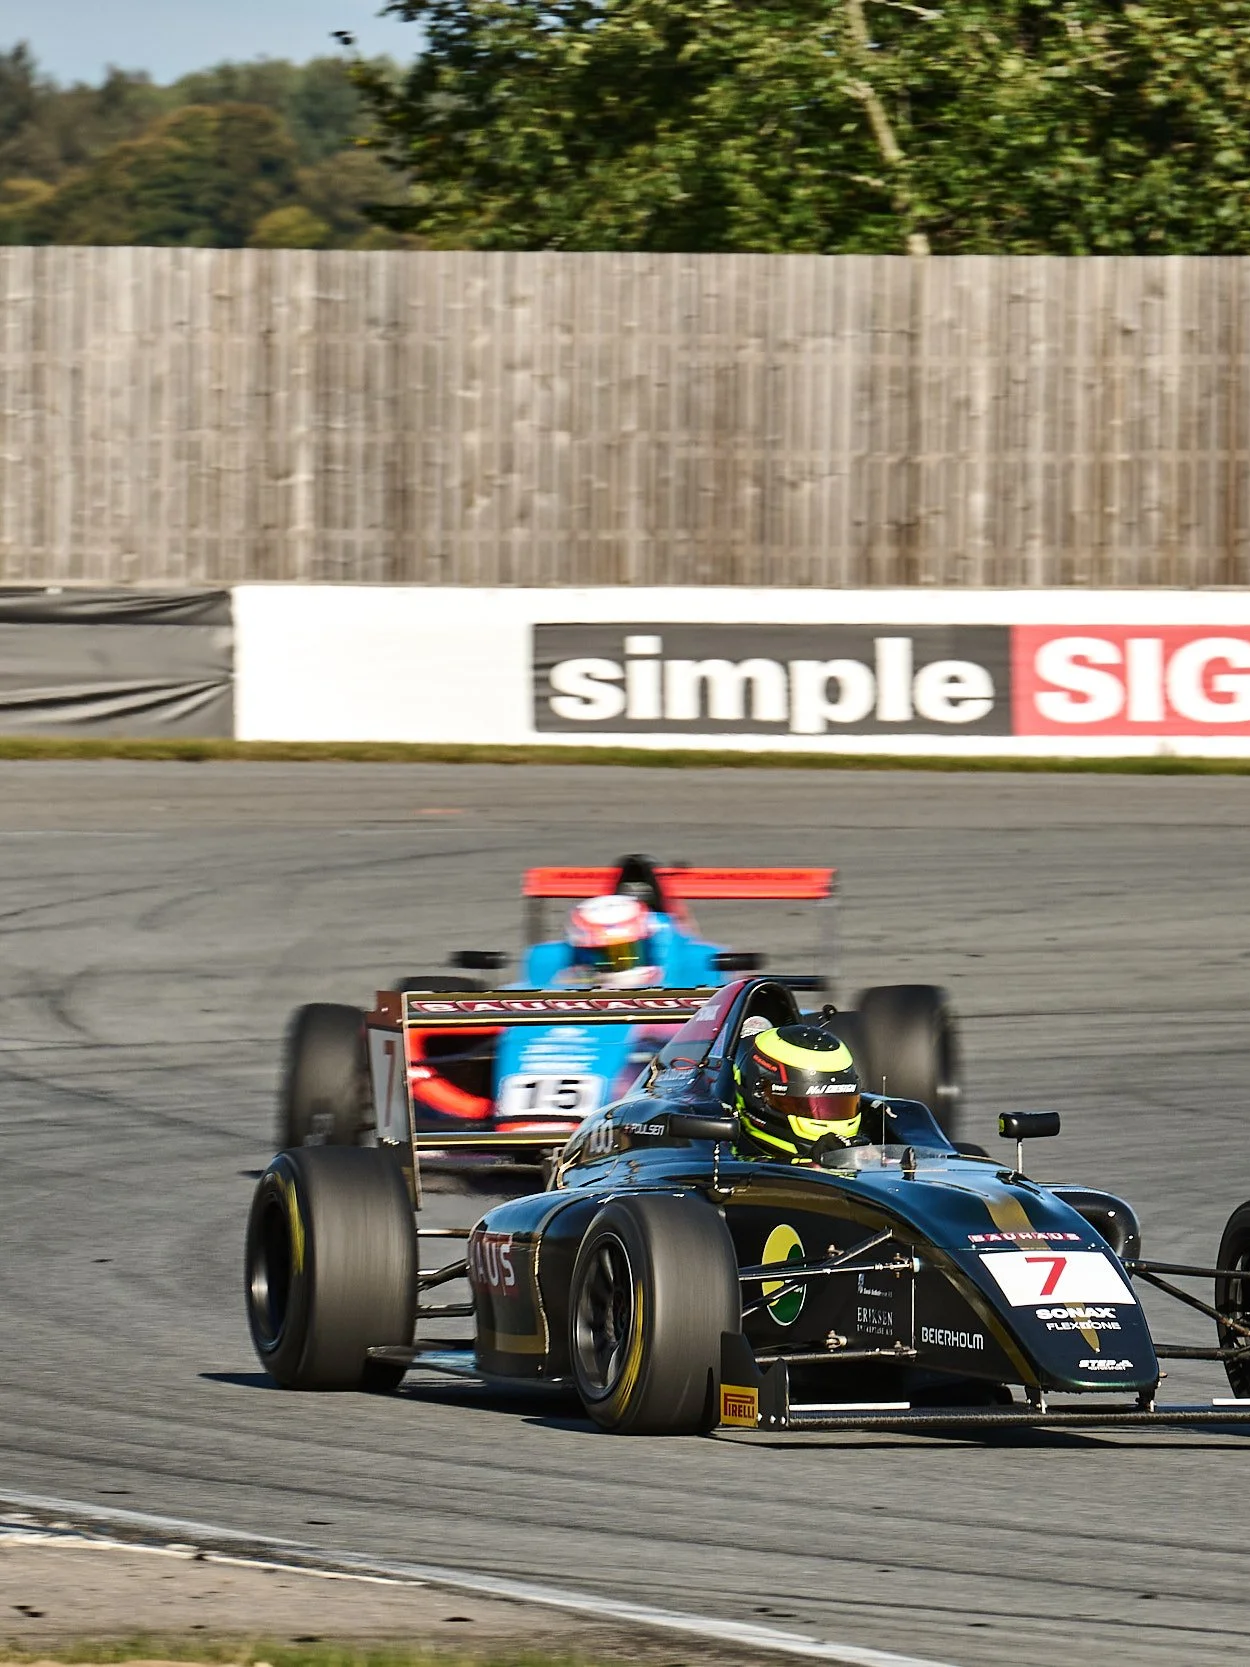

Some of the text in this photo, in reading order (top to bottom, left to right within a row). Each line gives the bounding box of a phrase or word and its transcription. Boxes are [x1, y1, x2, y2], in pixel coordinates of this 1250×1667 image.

[547, 635, 994, 734] simple
[384, 1040, 396, 1127] 7
[517, 1078, 583, 1111] 15
[968, 1232, 1081, 1244] BAUHAUS
[1025, 1256, 1067, 1296] 7
[1035, 1307, 1117, 1320] SONAX
[921, 1326, 984, 1350] BEIERHOLM
[724, 1392, 755, 1420] PIRELLI
